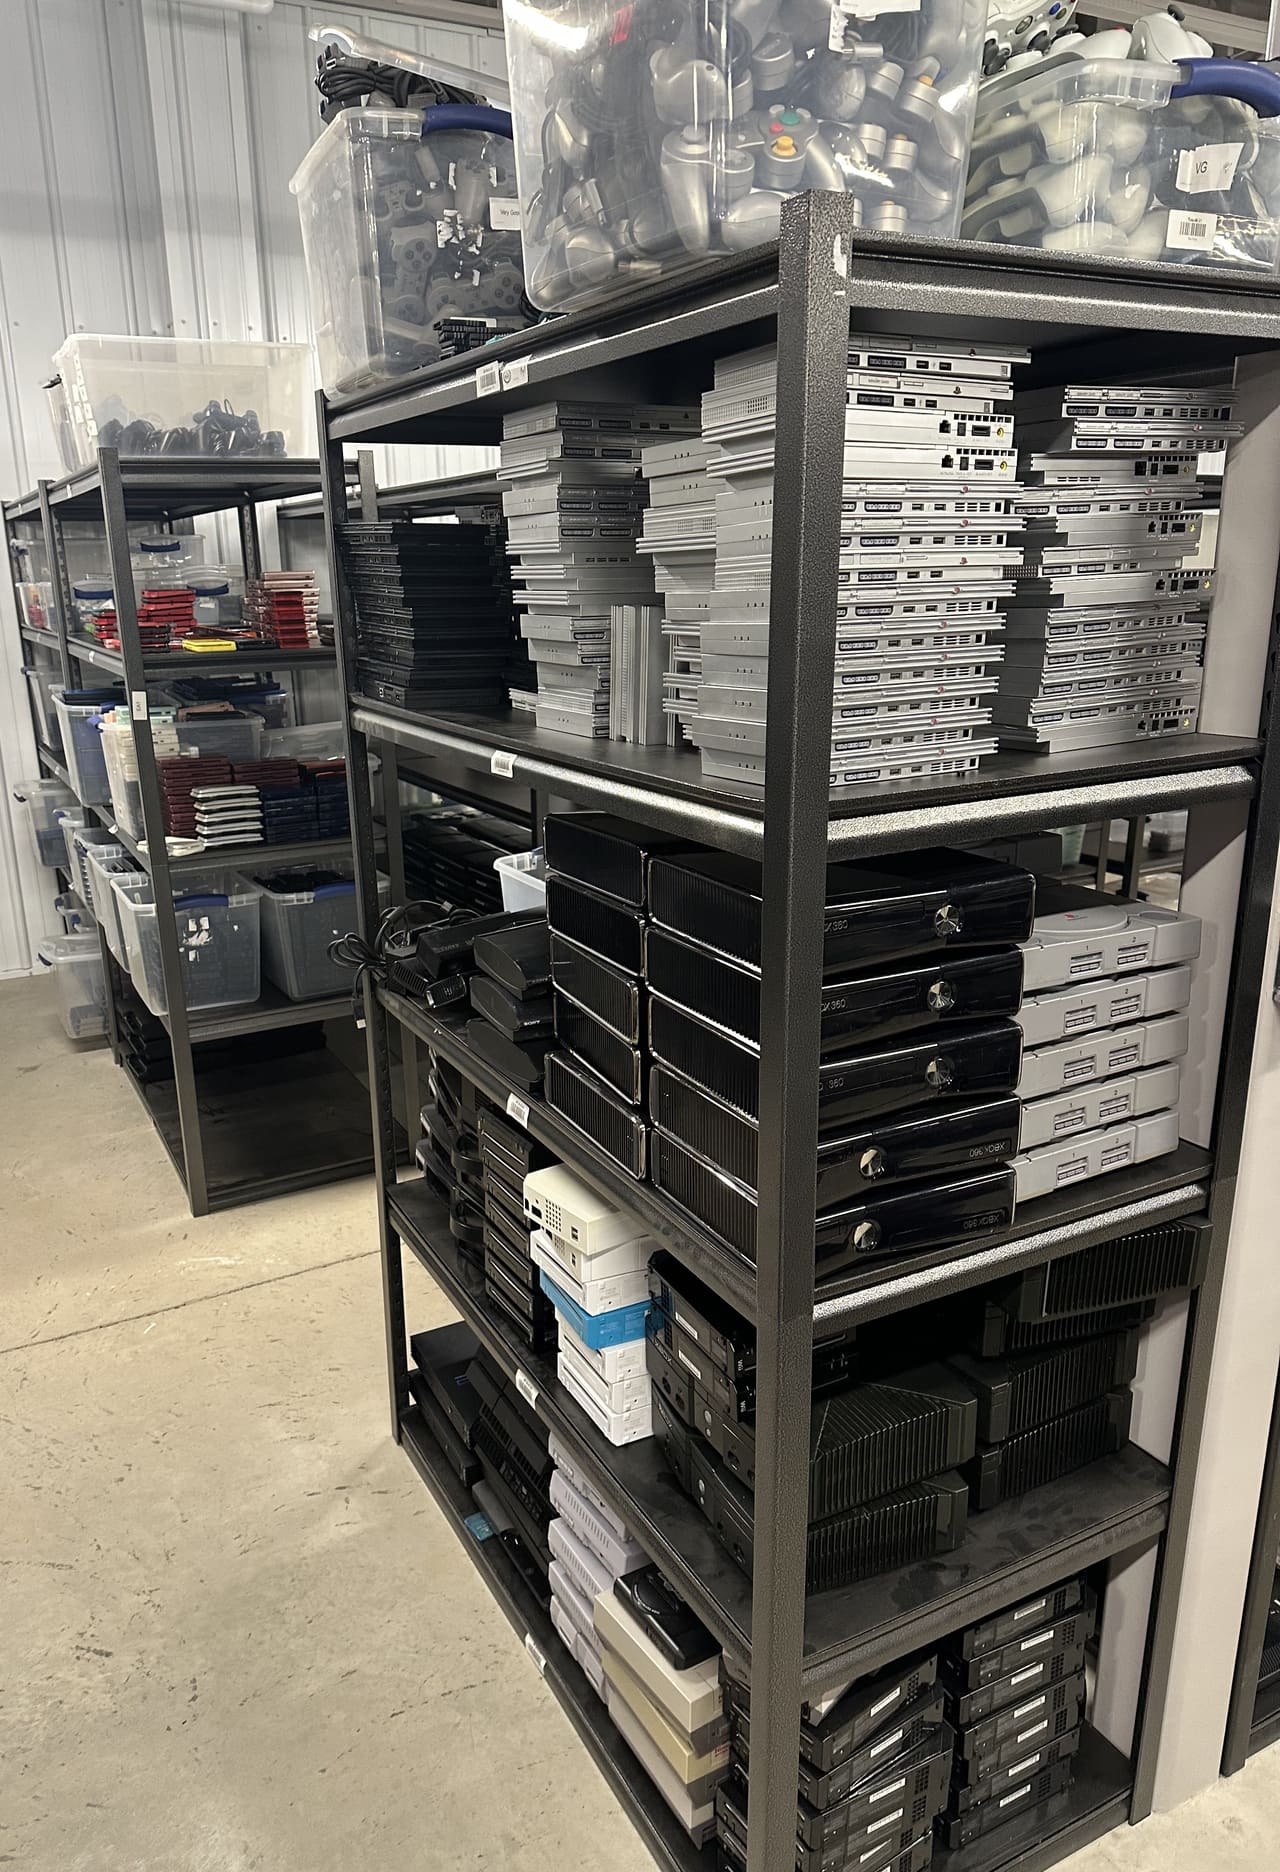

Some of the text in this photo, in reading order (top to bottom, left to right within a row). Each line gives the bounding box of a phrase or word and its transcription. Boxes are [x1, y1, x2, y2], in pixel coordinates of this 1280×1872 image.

[1195, 161, 1208, 175] VG
[832, 919, 848, 932] 360
[830, 998, 847, 1010] 360
[969, 1141, 1006, 1158] XBOX 360
[979, 1213, 1000, 1225] XBOX
